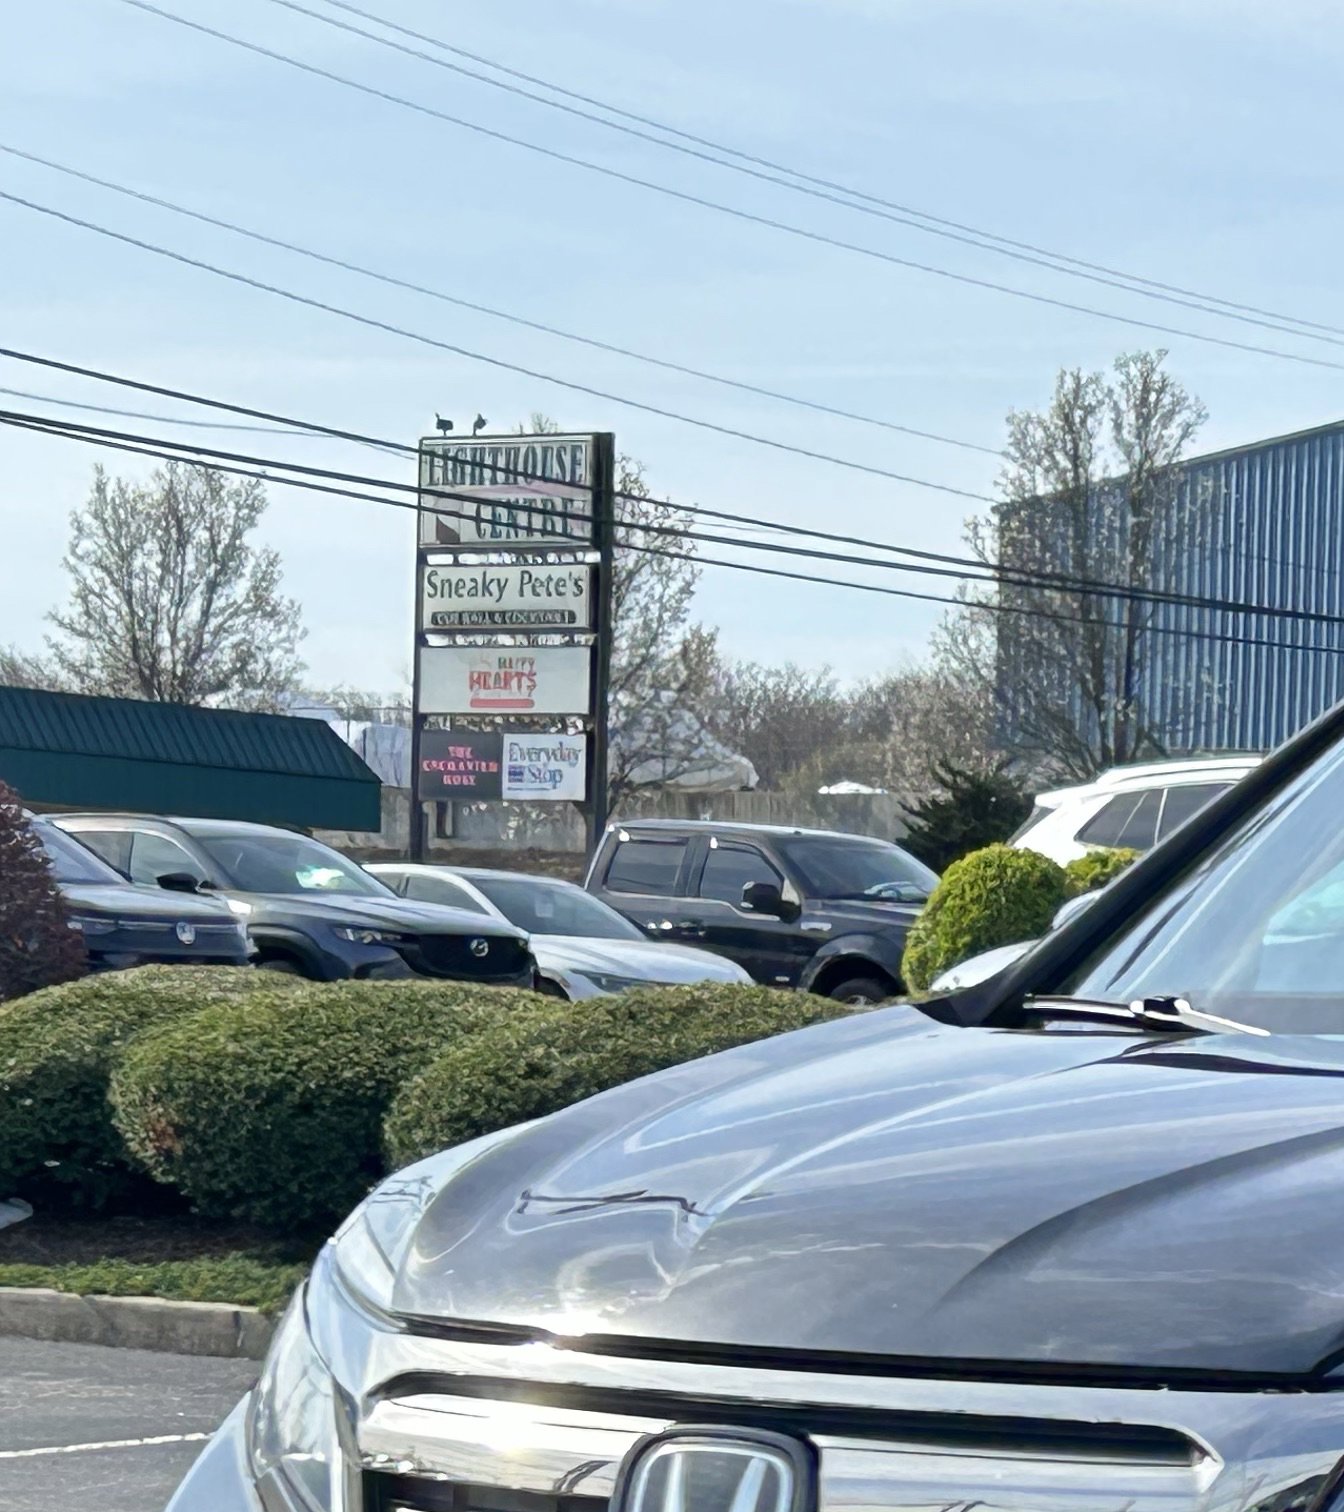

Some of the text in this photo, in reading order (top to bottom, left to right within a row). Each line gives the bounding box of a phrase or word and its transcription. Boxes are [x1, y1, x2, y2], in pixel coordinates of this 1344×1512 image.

[426, 569, 584, 602] Sneaky Pete's
[508, 741, 582, 767] Everyday
[528, 764, 564, 790] Stop
